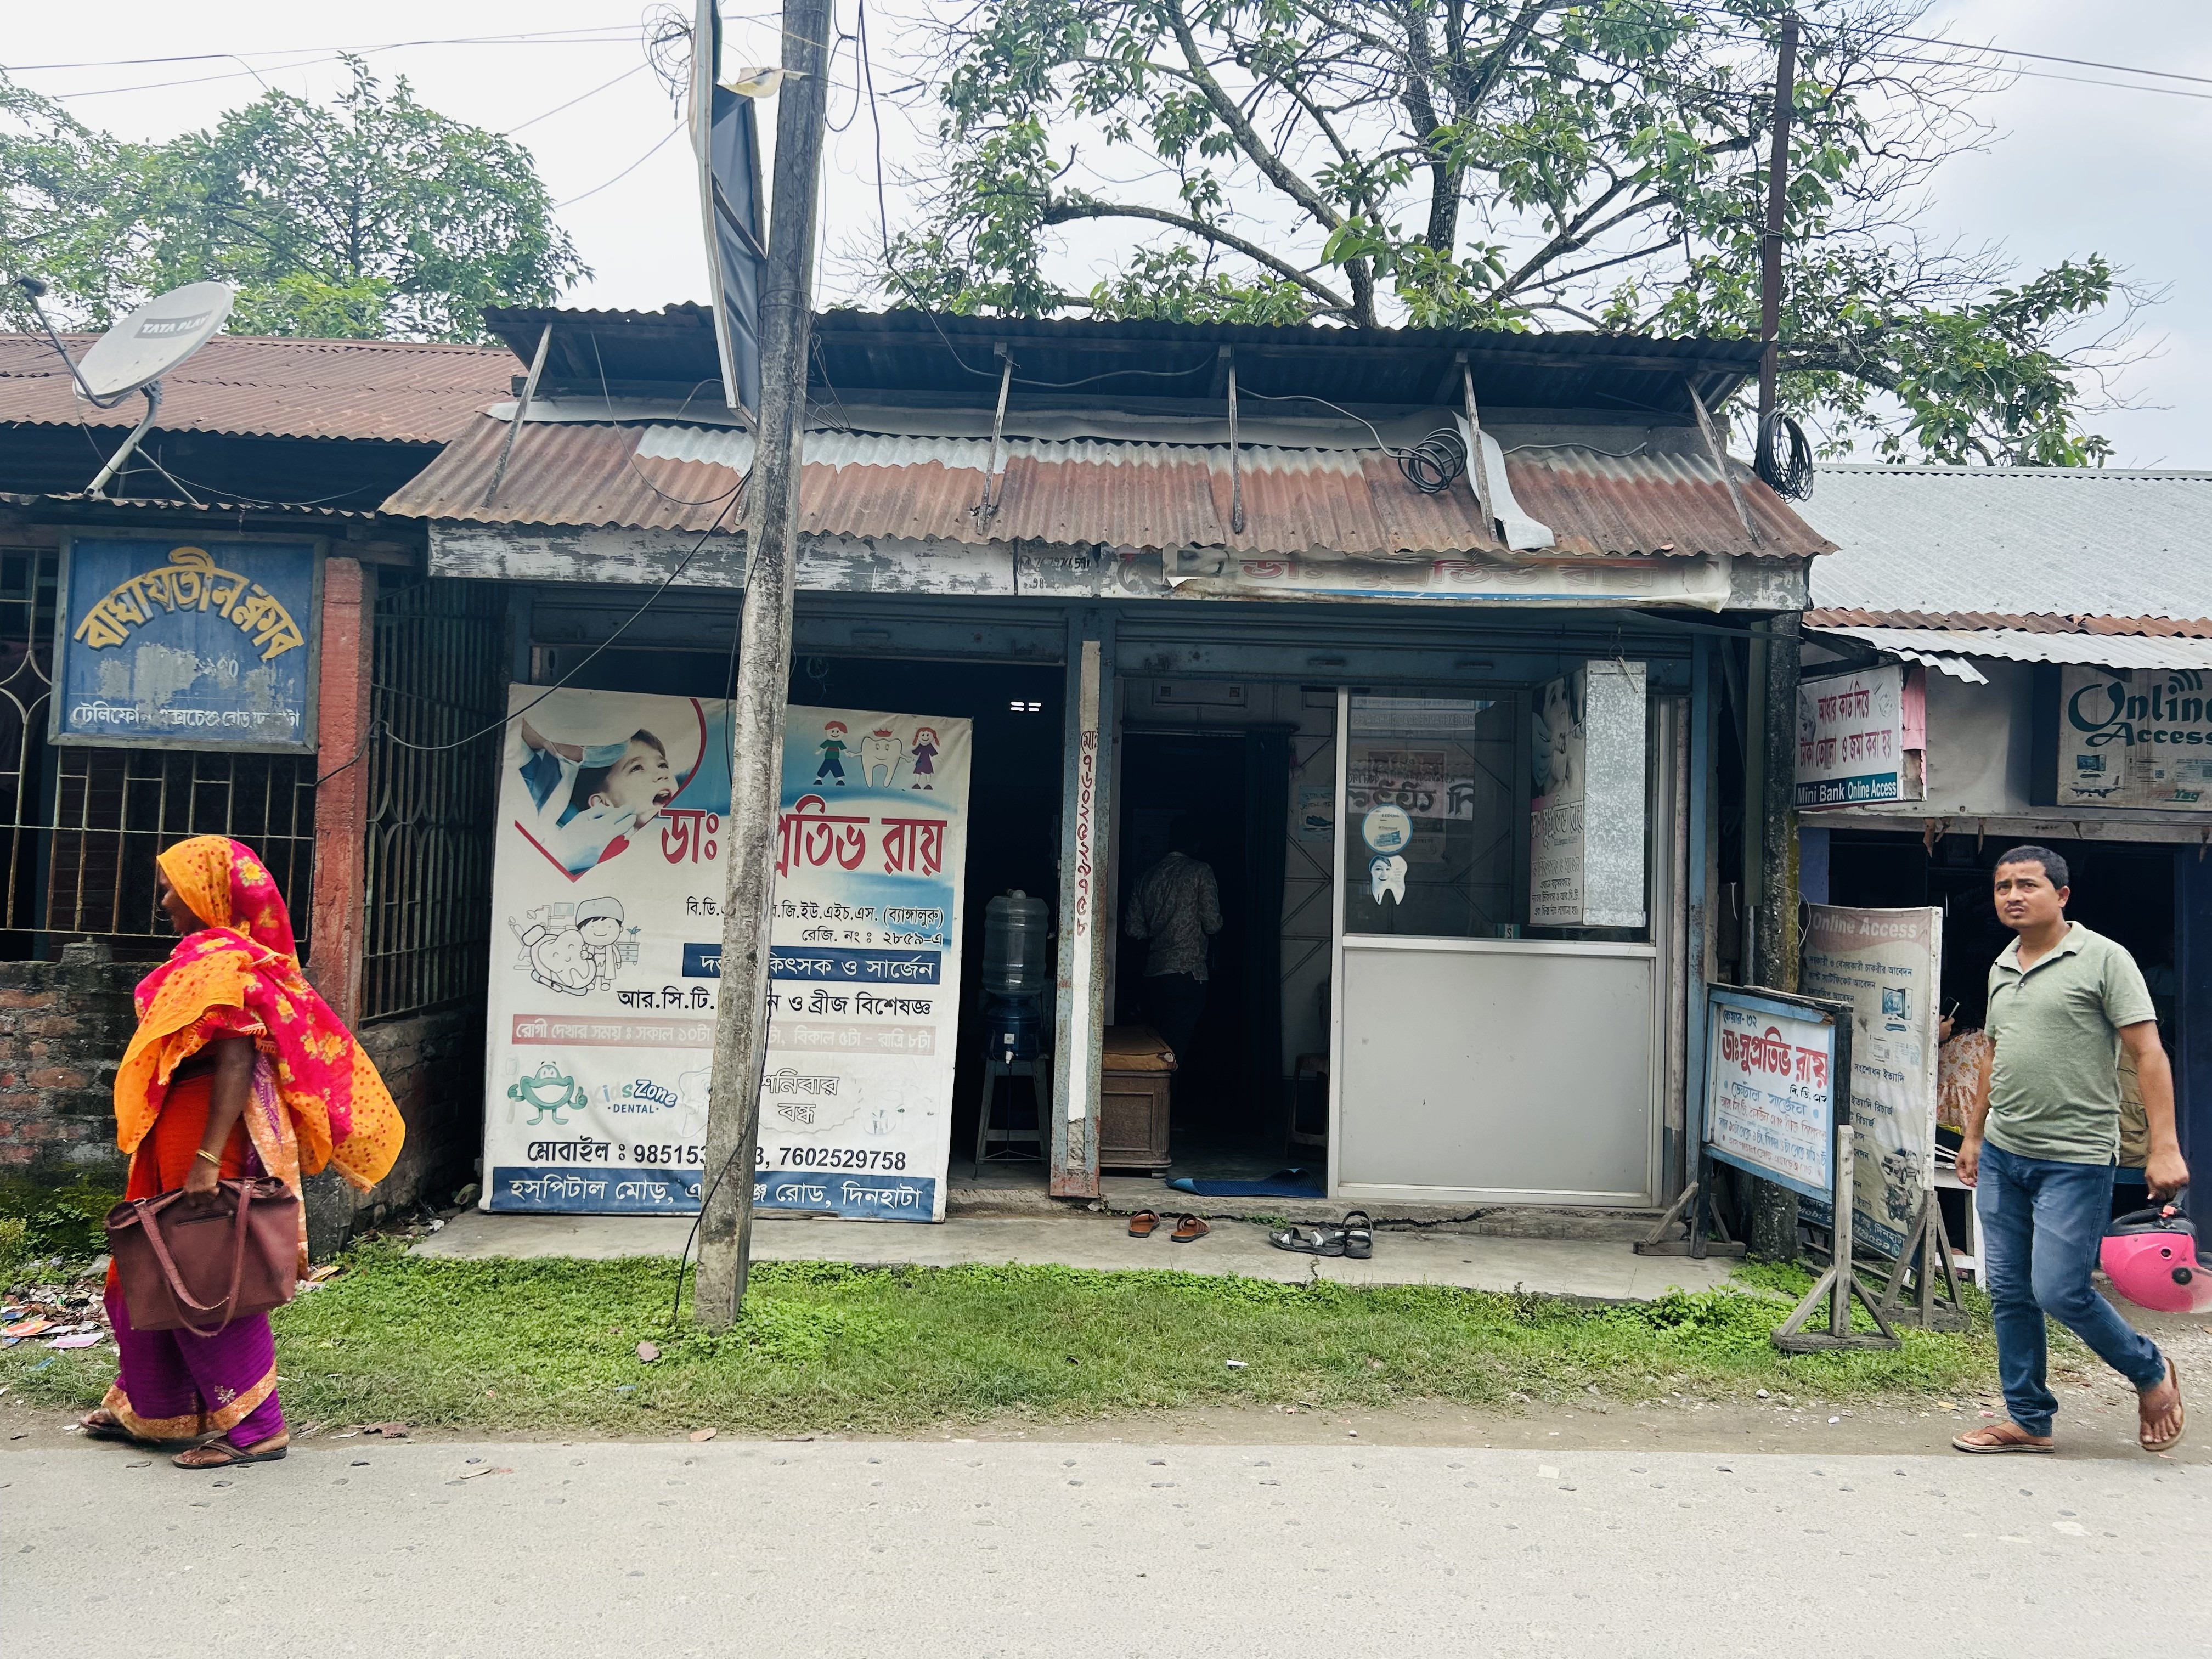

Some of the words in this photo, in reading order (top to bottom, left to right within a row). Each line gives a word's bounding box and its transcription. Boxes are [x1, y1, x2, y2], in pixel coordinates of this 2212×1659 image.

[142, 323, 176, 335] TATA
[176, 315, 209, 331] PLAY
[74, 546, 250, 649] বাঘাযতীন
[70, 700, 151, 727] টেলিফো
[1818, 693, 1837, 725] আধার
[1853, 680, 1870, 719] দিয়ে
[1849, 729, 1864, 763] জমা
[1865, 727, 1880, 760] করা
[1797, 785, 1817, 805] Mini
[1819, 782, 1846, 803] Bank
[1847, 780, 1870, 800] Online
[1871, 779, 1897, 798] Access
[659, 809, 719, 865] ডাঃ
[881, 817, 948, 878] রায়
[686, 896, 724, 917] বি.ডি.
[772, 900, 878, 922] .জি.ইউ.এইচ.এস.
[802, 926, 837, 944] রেজি.
[1812, 912, 1856, 935] Online
[1859, 917, 1918, 939] Access
[770, 952, 834, 977] কিৎসক
[841, 962, 857, 977] ও
[866, 955, 935, 981] সার্জেন
[1887, 966, 1912, 978] আবেদন
[617, 985, 715, 1011] আর.সি.টি.
[788, 996, 803, 1012] ও
[808, 989, 850, 1016] ব্রীজ
[854, 991, 934, 1017] বিশেষজ্ঞ
[516, 1018, 548, 1039] রোগী
[551, 1024, 589, 1040] দেখার
[591, 1024, 623, 1041] সময়
[636, 1025, 674, 1042] সকাল
[678, 1024, 712, 1042] ১০টা
[794, 1024, 836, 1046] বিকাল
[1796, 1046, 1828, 1089] রায়
[1882, 1067, 1905, 1085] ইত্যাদি
[777, 1103, 816, 1124] বন্ধ
[527, 1135, 612, 1162] মোবাইল
[779, 1147, 907, 1171] 7602529758
[615, 1178, 675, 1205] মোড়,
[775, 1182, 832, 1209] রোড,
[840, 1180, 924, 1210] দিনহাটা
